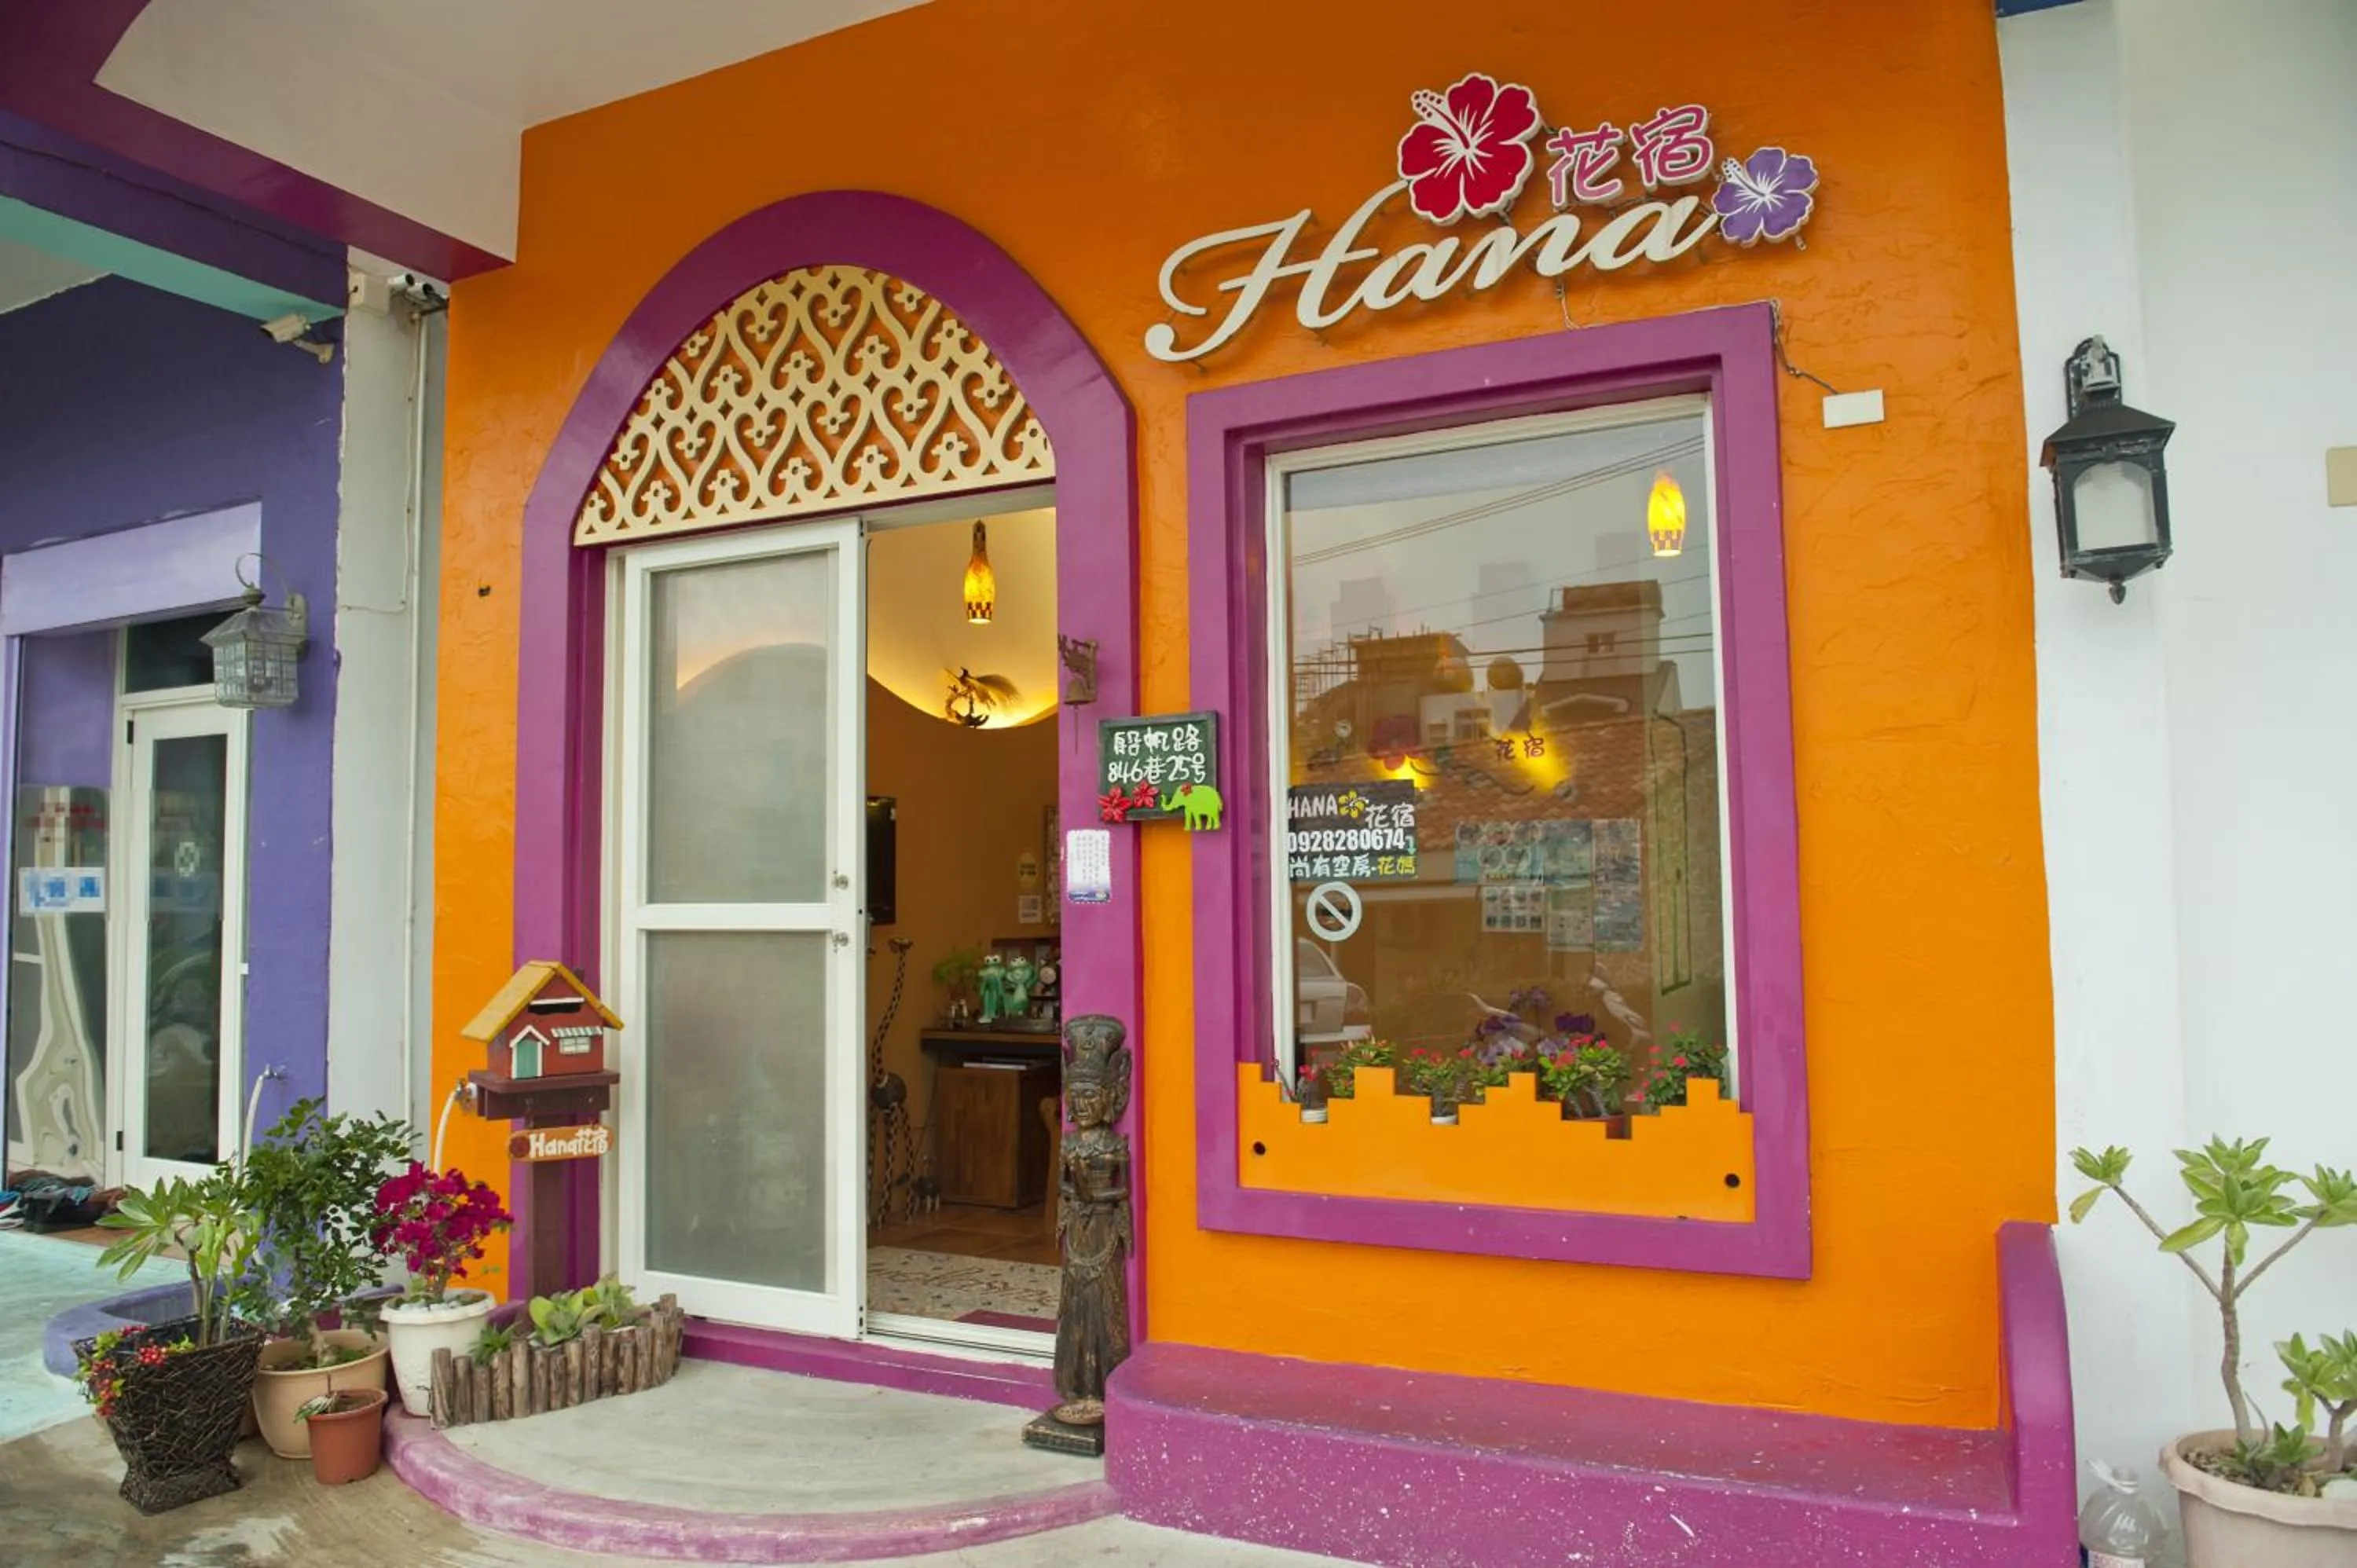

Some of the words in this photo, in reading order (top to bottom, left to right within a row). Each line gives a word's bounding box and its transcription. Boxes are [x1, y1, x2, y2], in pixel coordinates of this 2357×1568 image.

[1545, 104, 1714, 210] 花宿
[1145, 179, 1720, 361] Hana
[1288, 793, 1338, 819] HANA
[1365, 802, 1415, 828] 花宿
[1288, 828, 1405, 852] 0928280674
